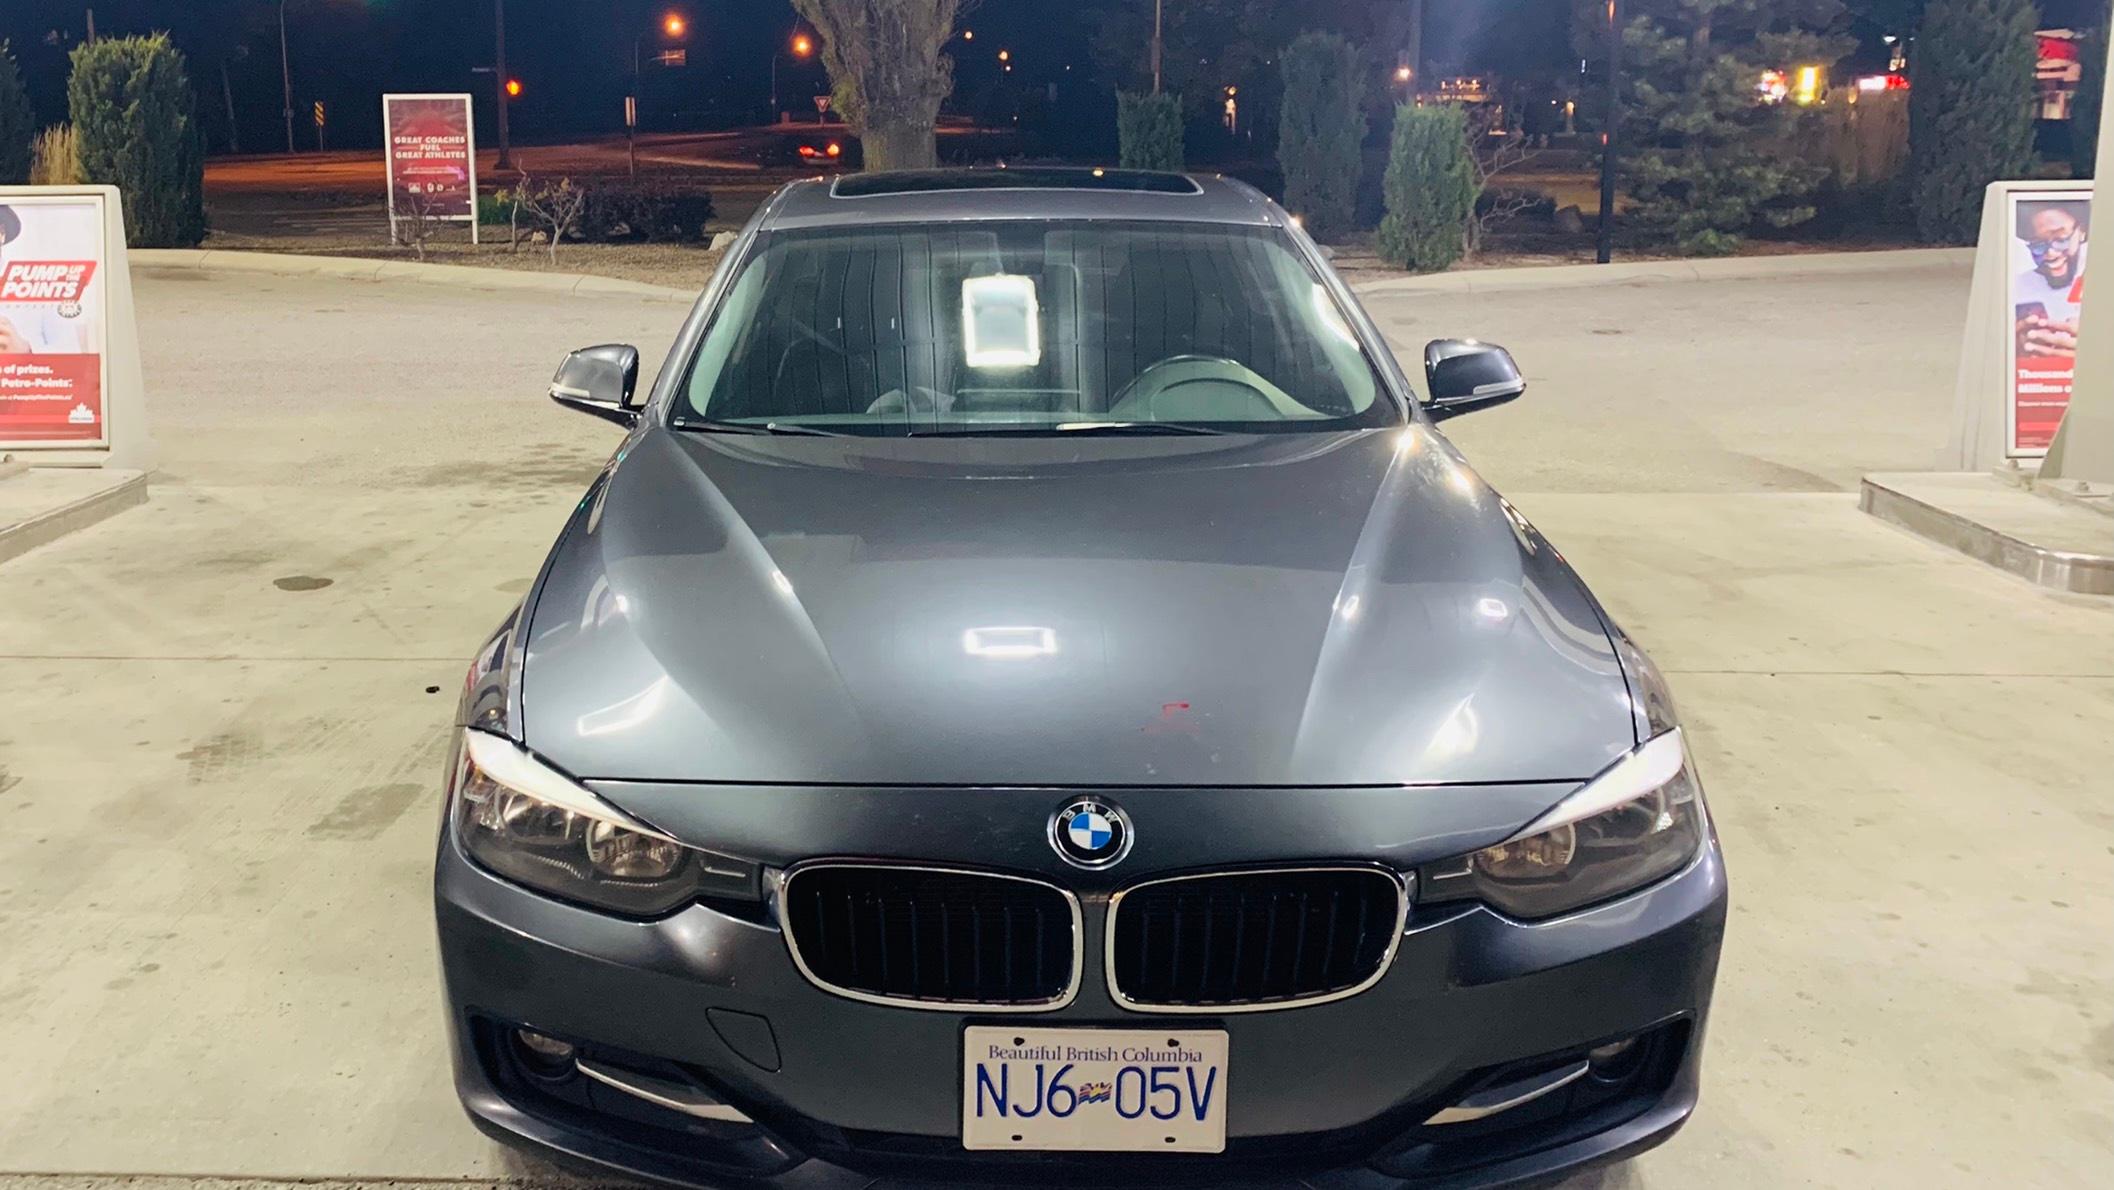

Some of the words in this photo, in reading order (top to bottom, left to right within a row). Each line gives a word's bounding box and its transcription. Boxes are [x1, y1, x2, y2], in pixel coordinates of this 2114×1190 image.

[394, 136, 423, 144] GREAT
[425, 136, 466, 144] COACHES
[395, 151, 423, 159] GREAT
[425, 151, 466, 159] ATHLETES
[9, 265, 68, 281] PUMP
[69, 264, 86, 273] UP
[0, 281, 79, 298] POINTS
[3, 364, 16, 374] of
[16, 364, 54, 376] prizes.
[2018, 368, 2074, 379] Thousand
[1062, 803, 1119, 823] BMW
[989, 1044, 1061, 1061] Beautiful
[1066, 1046, 1119, 1062] British
[1122, 1047, 1203, 1063] Columbia
[976, 1063, 1078, 1118] NJ6
[1115, 1065, 1217, 1121] 05V
